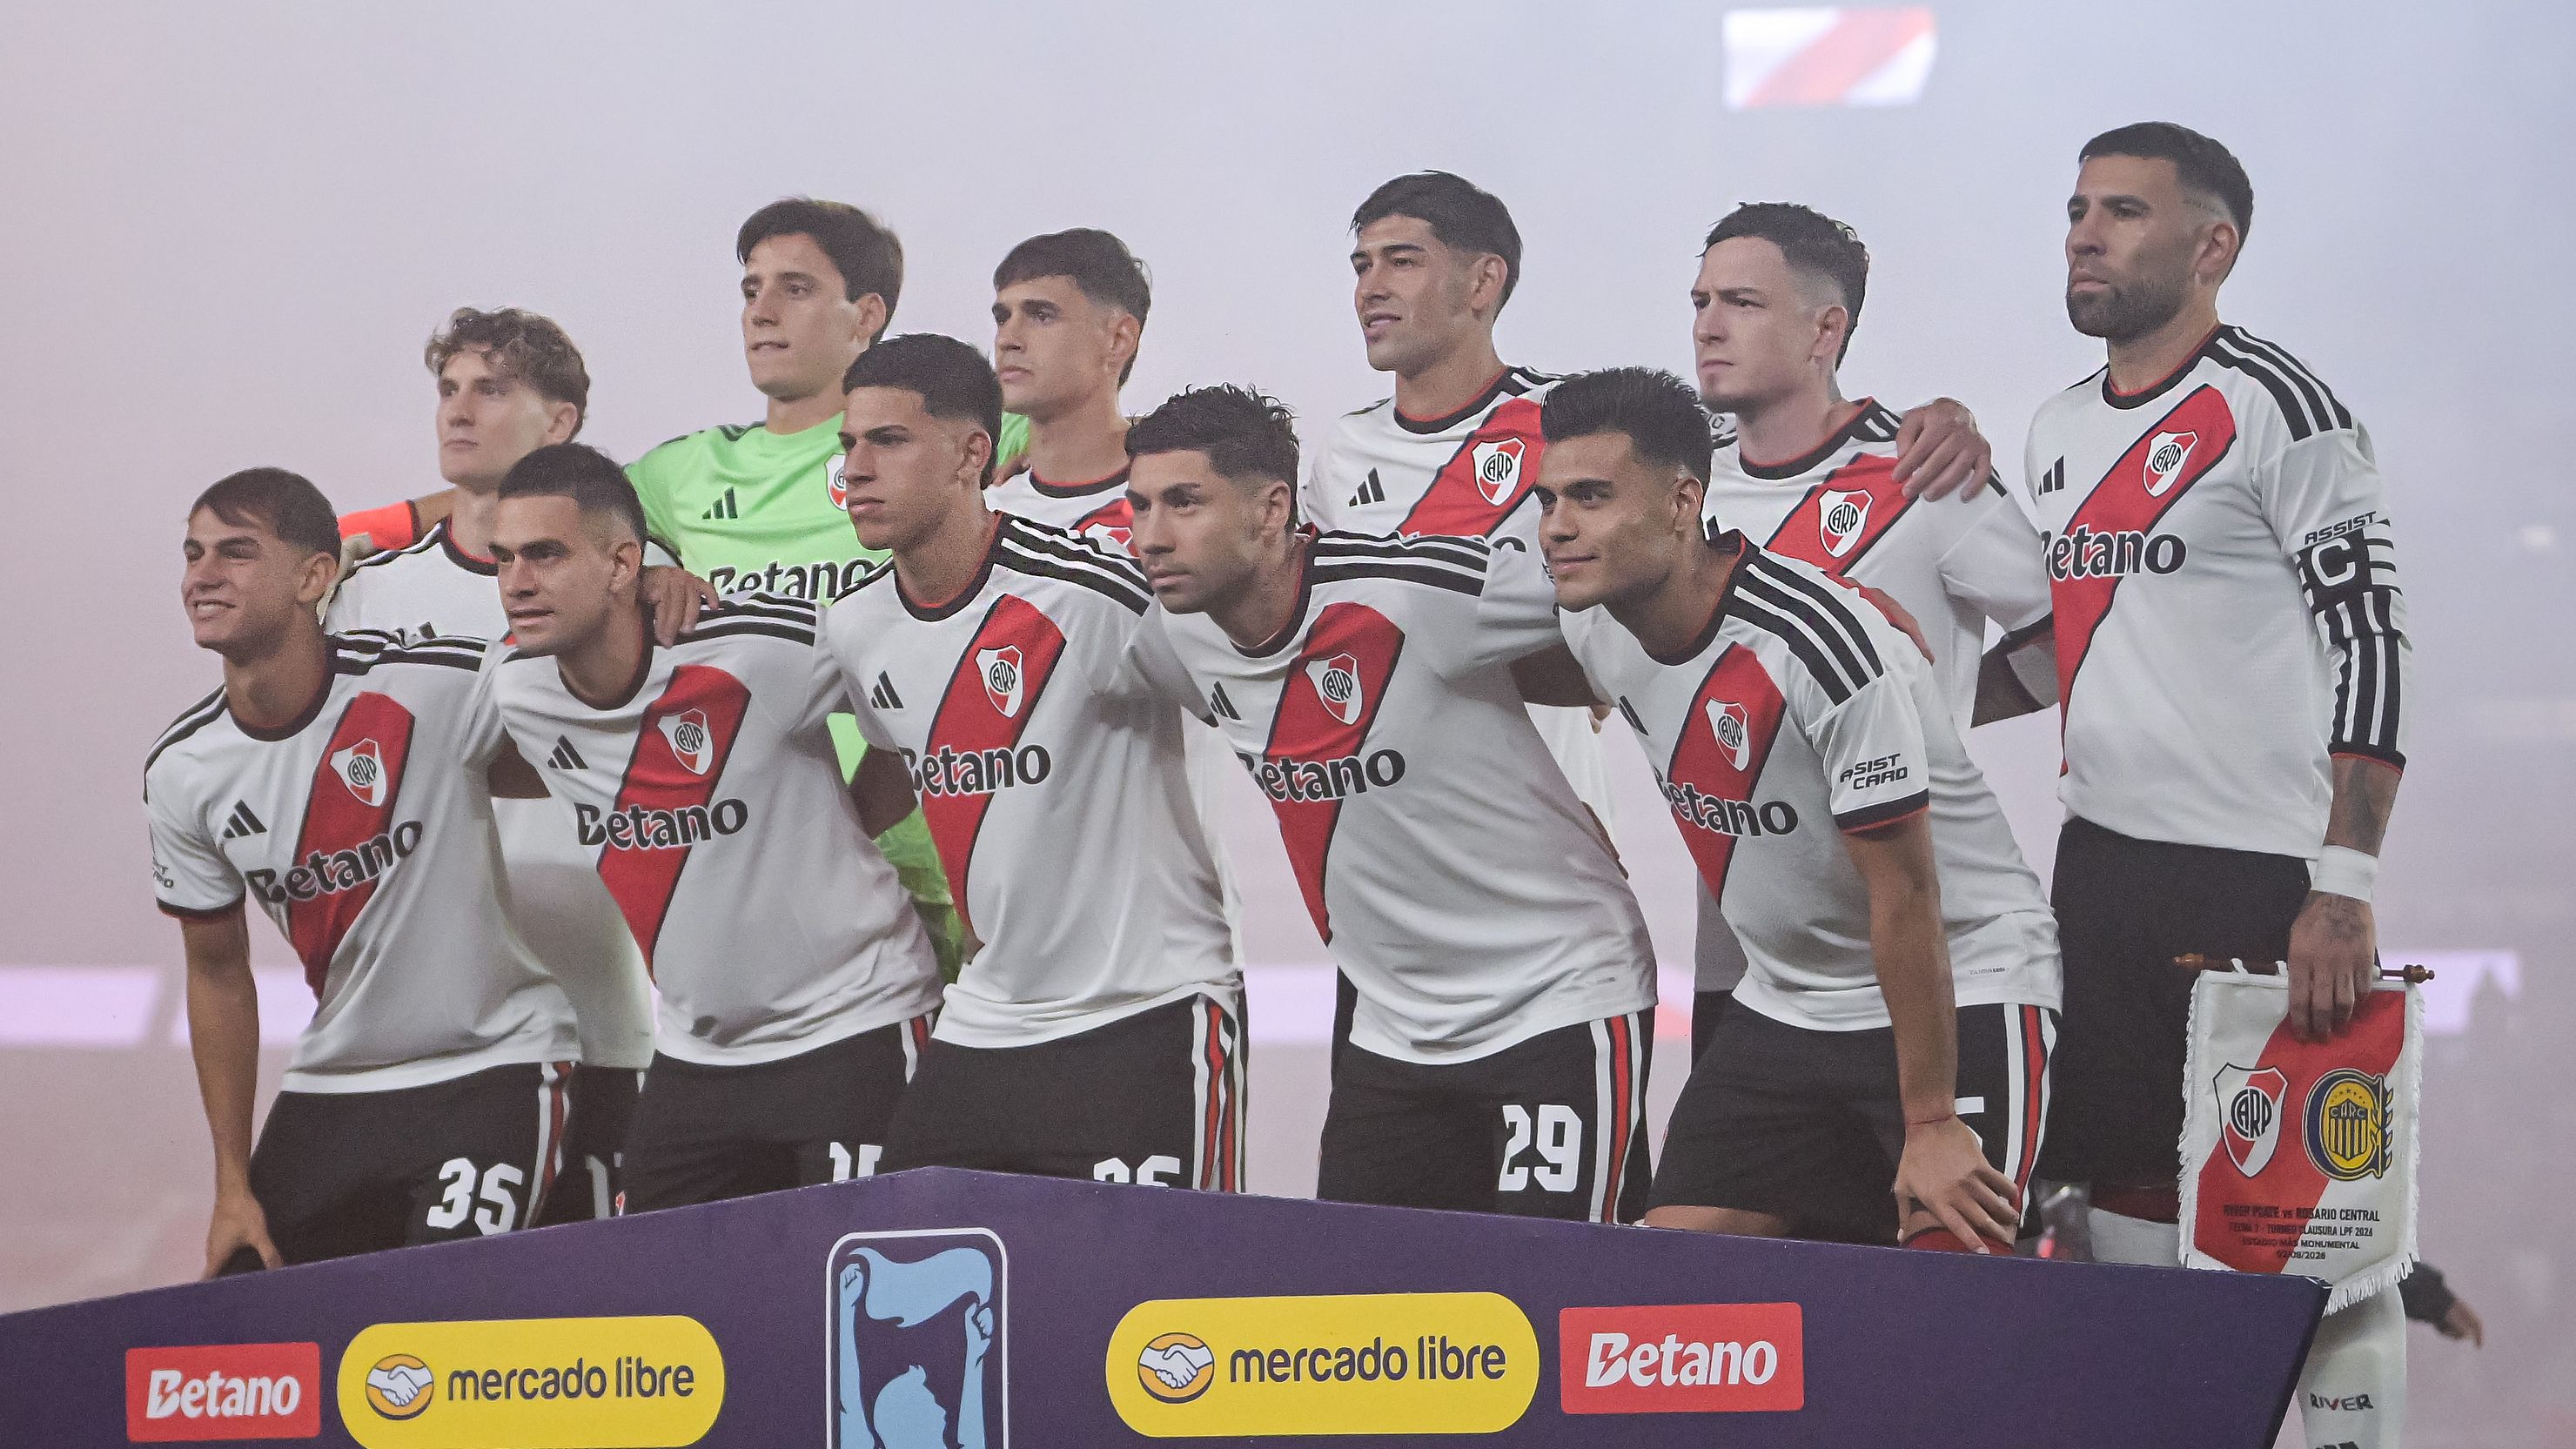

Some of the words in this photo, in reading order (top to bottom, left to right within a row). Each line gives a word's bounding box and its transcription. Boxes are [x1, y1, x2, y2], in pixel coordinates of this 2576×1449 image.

[2304, 510, 2377, 546] ASSIST
[2311, 537, 2356, 587] C
[1853, 766, 1909, 790] CARD
[574, 798, 749, 850] Betano
[245, 820, 424, 902] Betano
[1498, 1104, 1583, 1192] 29
[426, 1157, 523, 1237] 35
[2296, 1207, 2337, 1220] ROSARIO
[2339, 1208, 2380, 1222] CENTRAL
[2300, 1239, 2360, 1250] MONUMENTAL
[2339, 1226, 2353, 1237] LPF
[447, 1357, 607, 1401] mercado
[615, 1356, 694, 1398] libre
[1229, 1336, 1408, 1383] mercado
[1417, 1335, 1506, 1380] libre
[1585, 1332, 1778, 1388] Betano
[146, 1369, 301, 1419] Betano
[2309, 1392, 2374, 1411] RIVER
